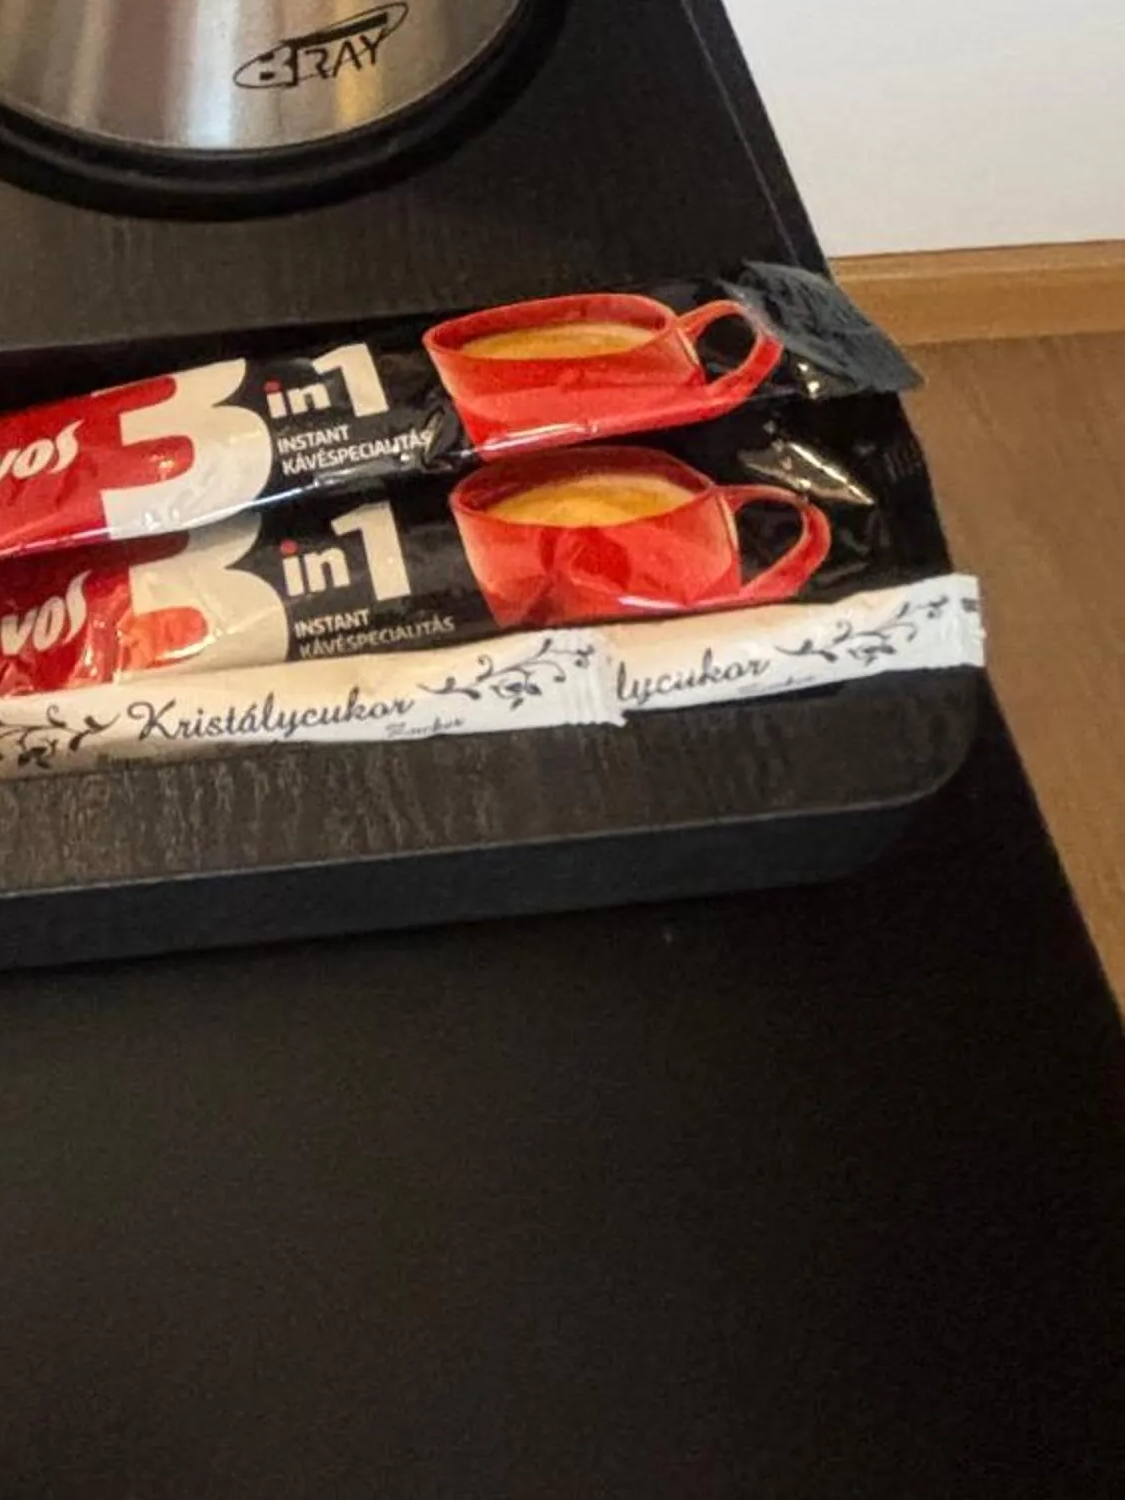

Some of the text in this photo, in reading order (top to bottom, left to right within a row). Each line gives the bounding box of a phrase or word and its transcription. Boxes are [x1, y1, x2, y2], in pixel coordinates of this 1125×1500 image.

[277, 425, 350, 454] INSTANT
[282, 427, 433, 476] KÁVÉSPECIALITÁS
[294, 607, 371, 638] INSTANT
[299, 615, 456, 660] KÁVÉSPECIALITÁS
[127, 690, 416, 741] Kristálycukor
